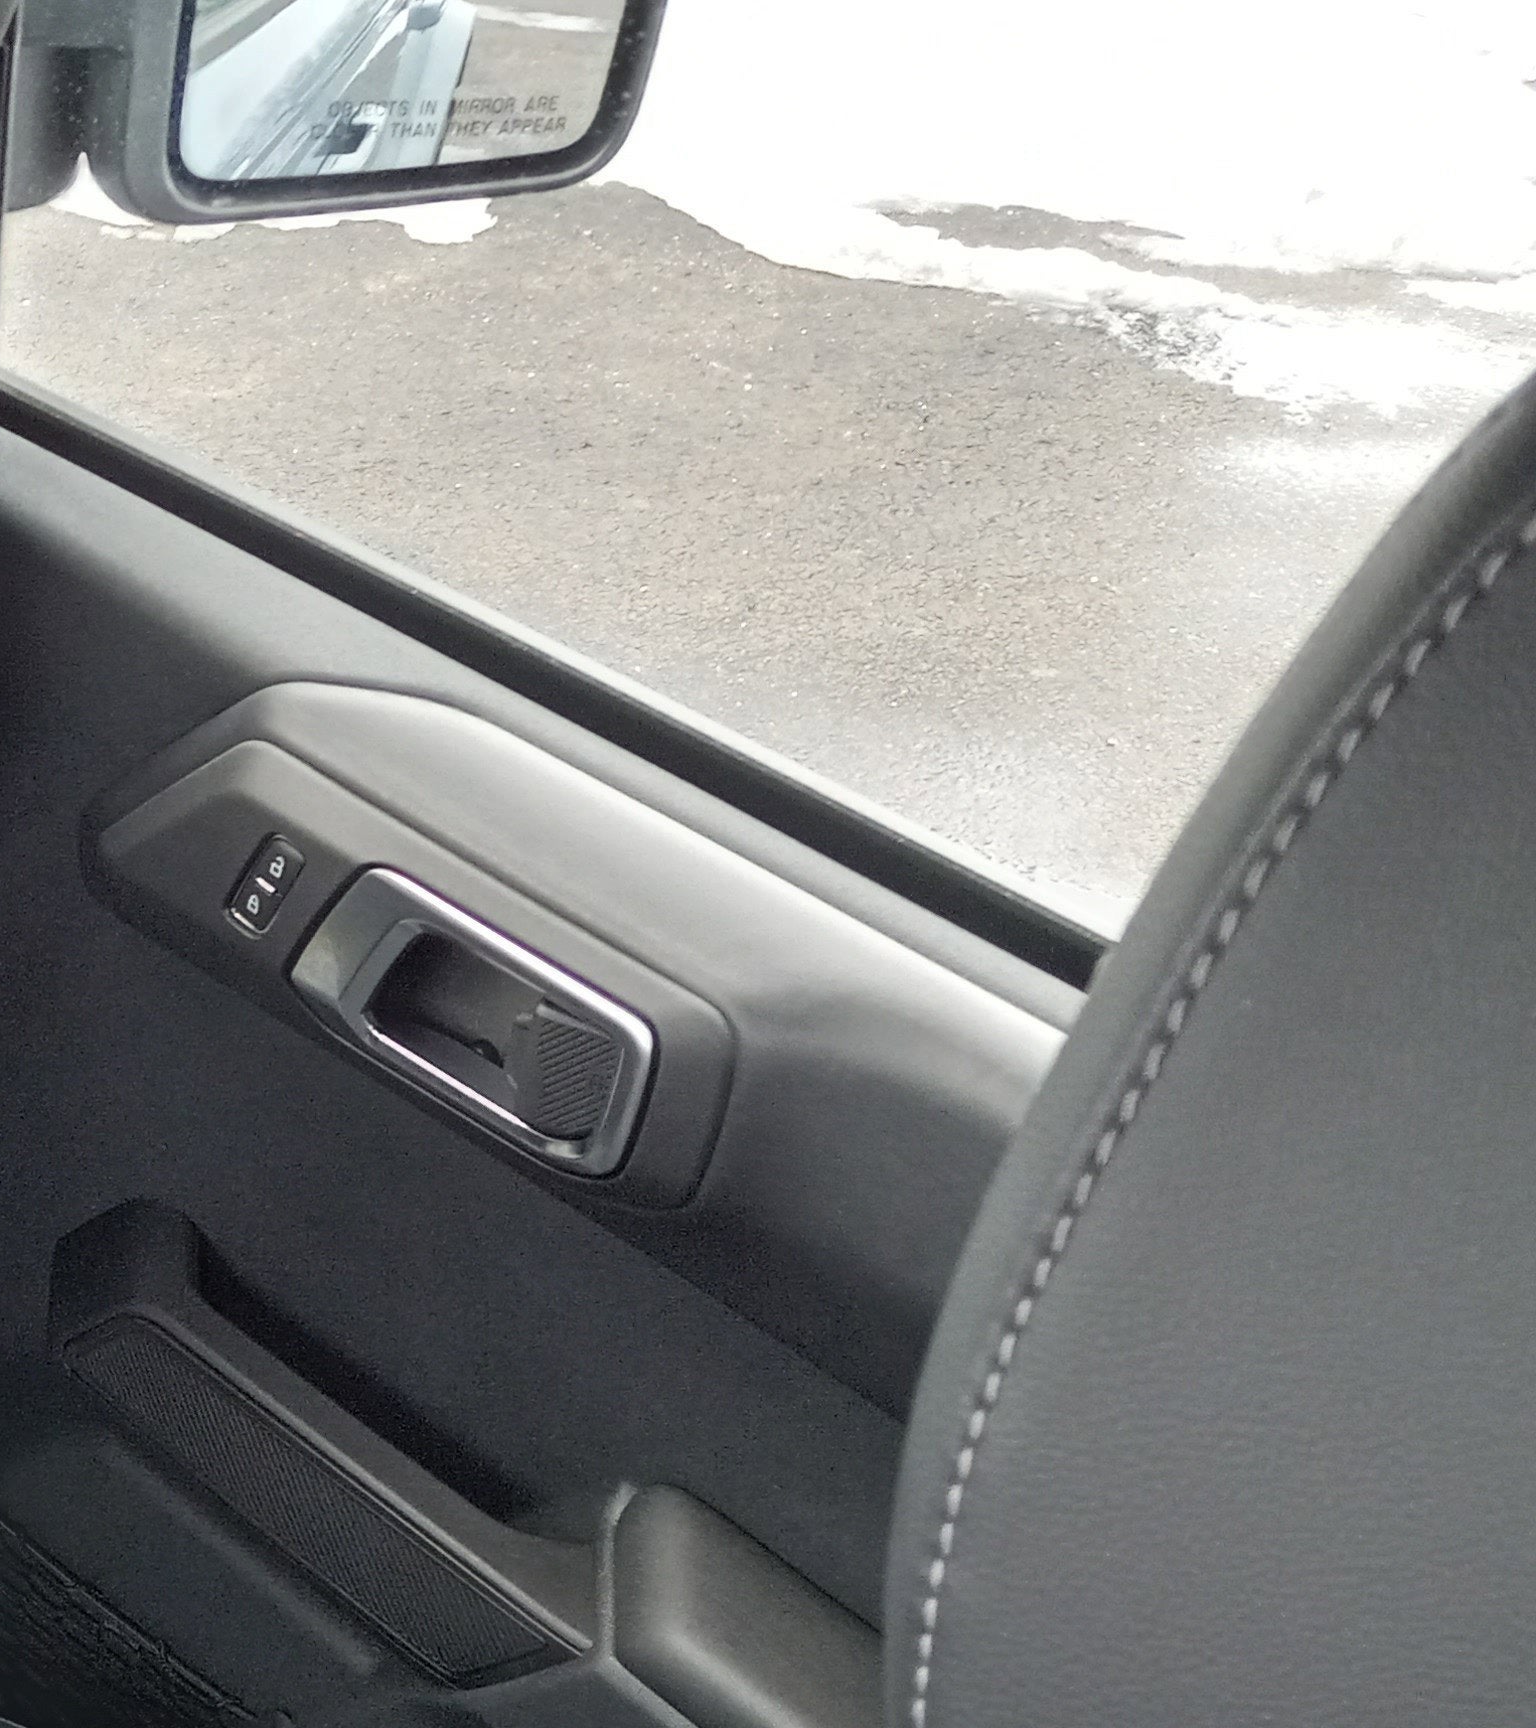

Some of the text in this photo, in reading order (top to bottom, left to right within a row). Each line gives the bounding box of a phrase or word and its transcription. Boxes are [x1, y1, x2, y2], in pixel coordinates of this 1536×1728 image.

[420, 100, 438, 115] IN
[451, 96, 516, 115] MIRROR
[523, 95, 560, 113] ARE
[390, 121, 439, 138] THAN
[448, 119, 493, 137] THEY
[497, 116, 568, 136] APPEAR
